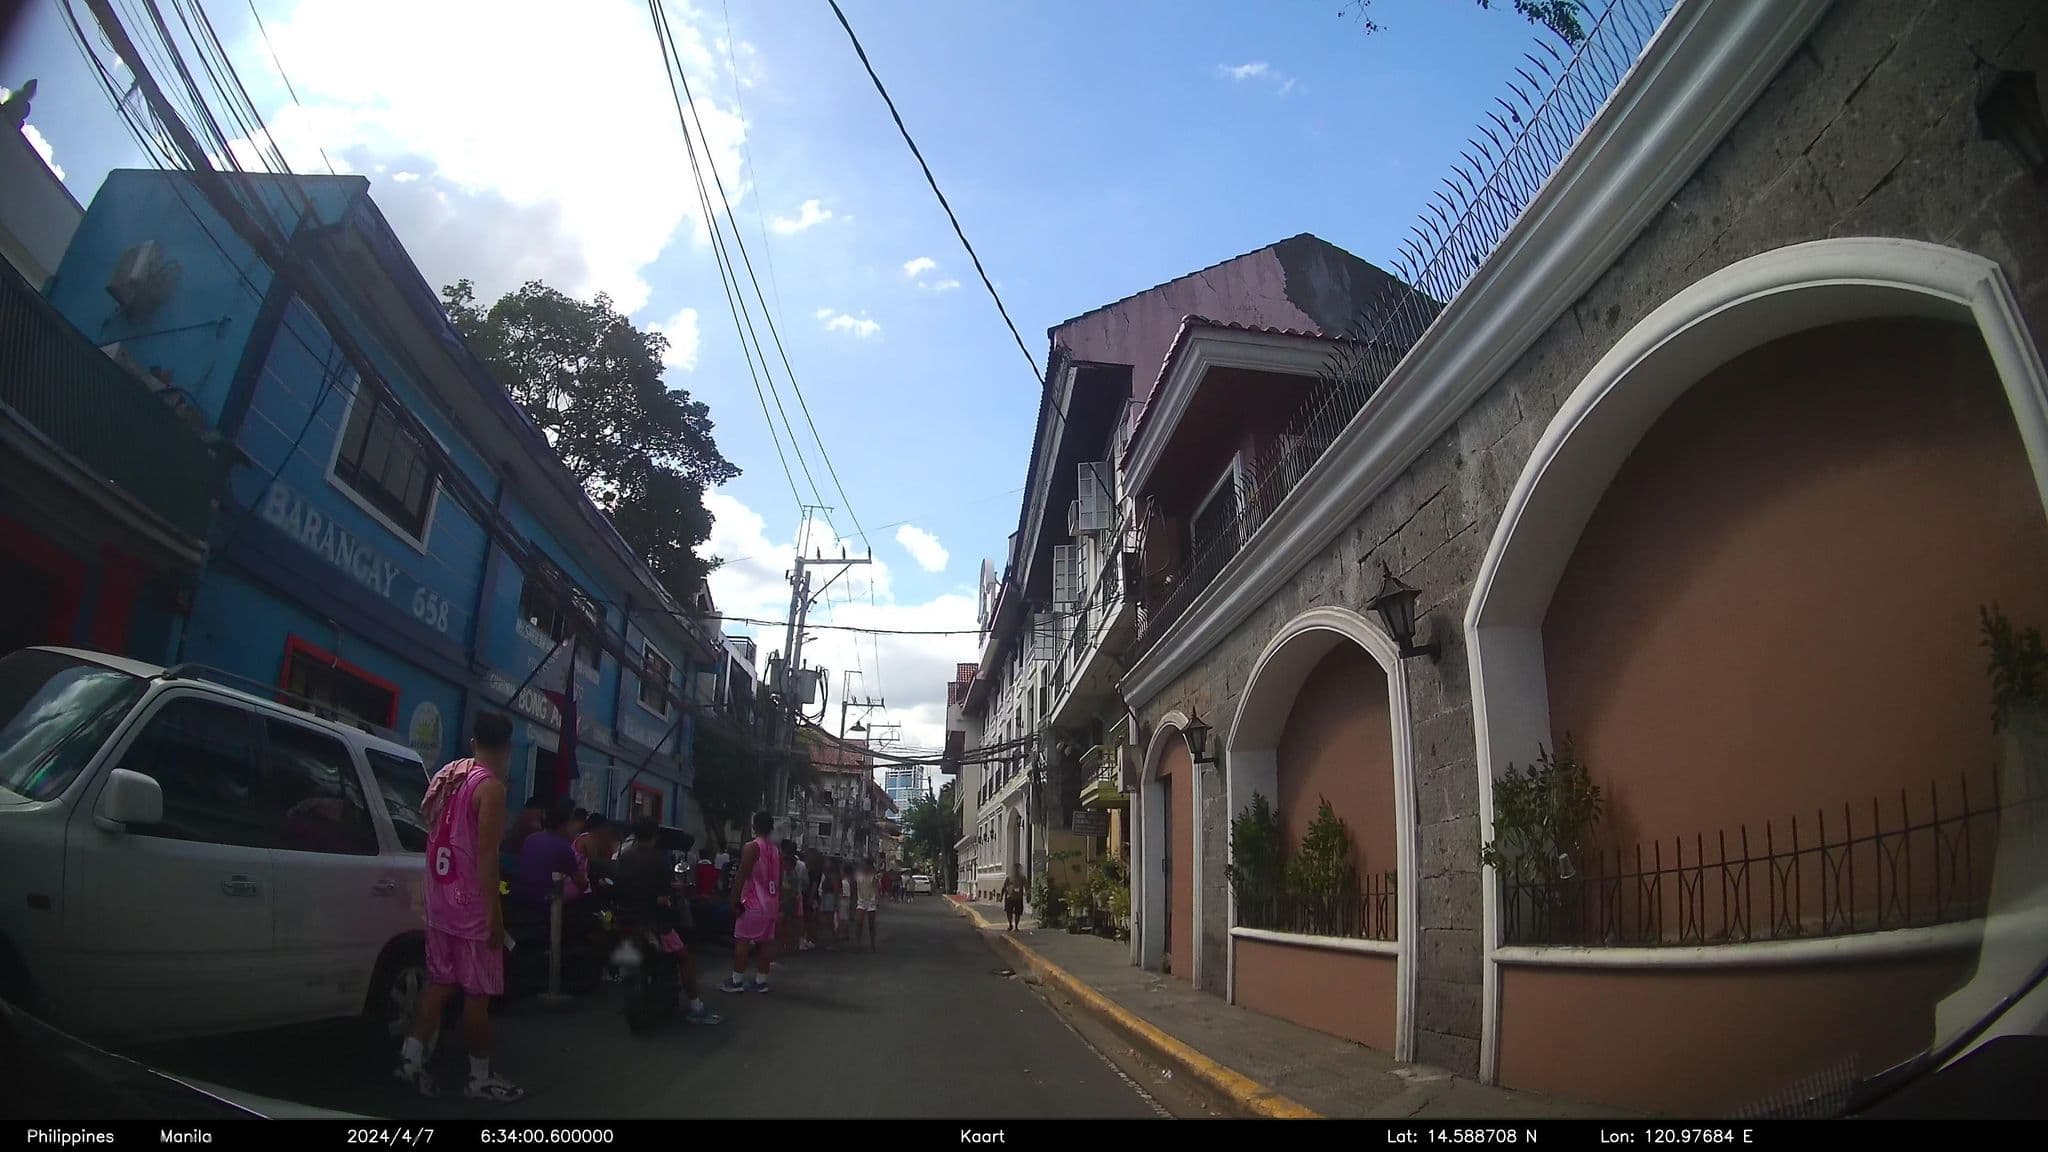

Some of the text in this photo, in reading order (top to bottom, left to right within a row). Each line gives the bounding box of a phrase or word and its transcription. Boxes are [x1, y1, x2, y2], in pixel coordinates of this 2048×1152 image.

[263, 484, 449, 633] BARANGAY 658
[518, 686, 548, 720] BONG
[435, 846, 452, 876] 6
